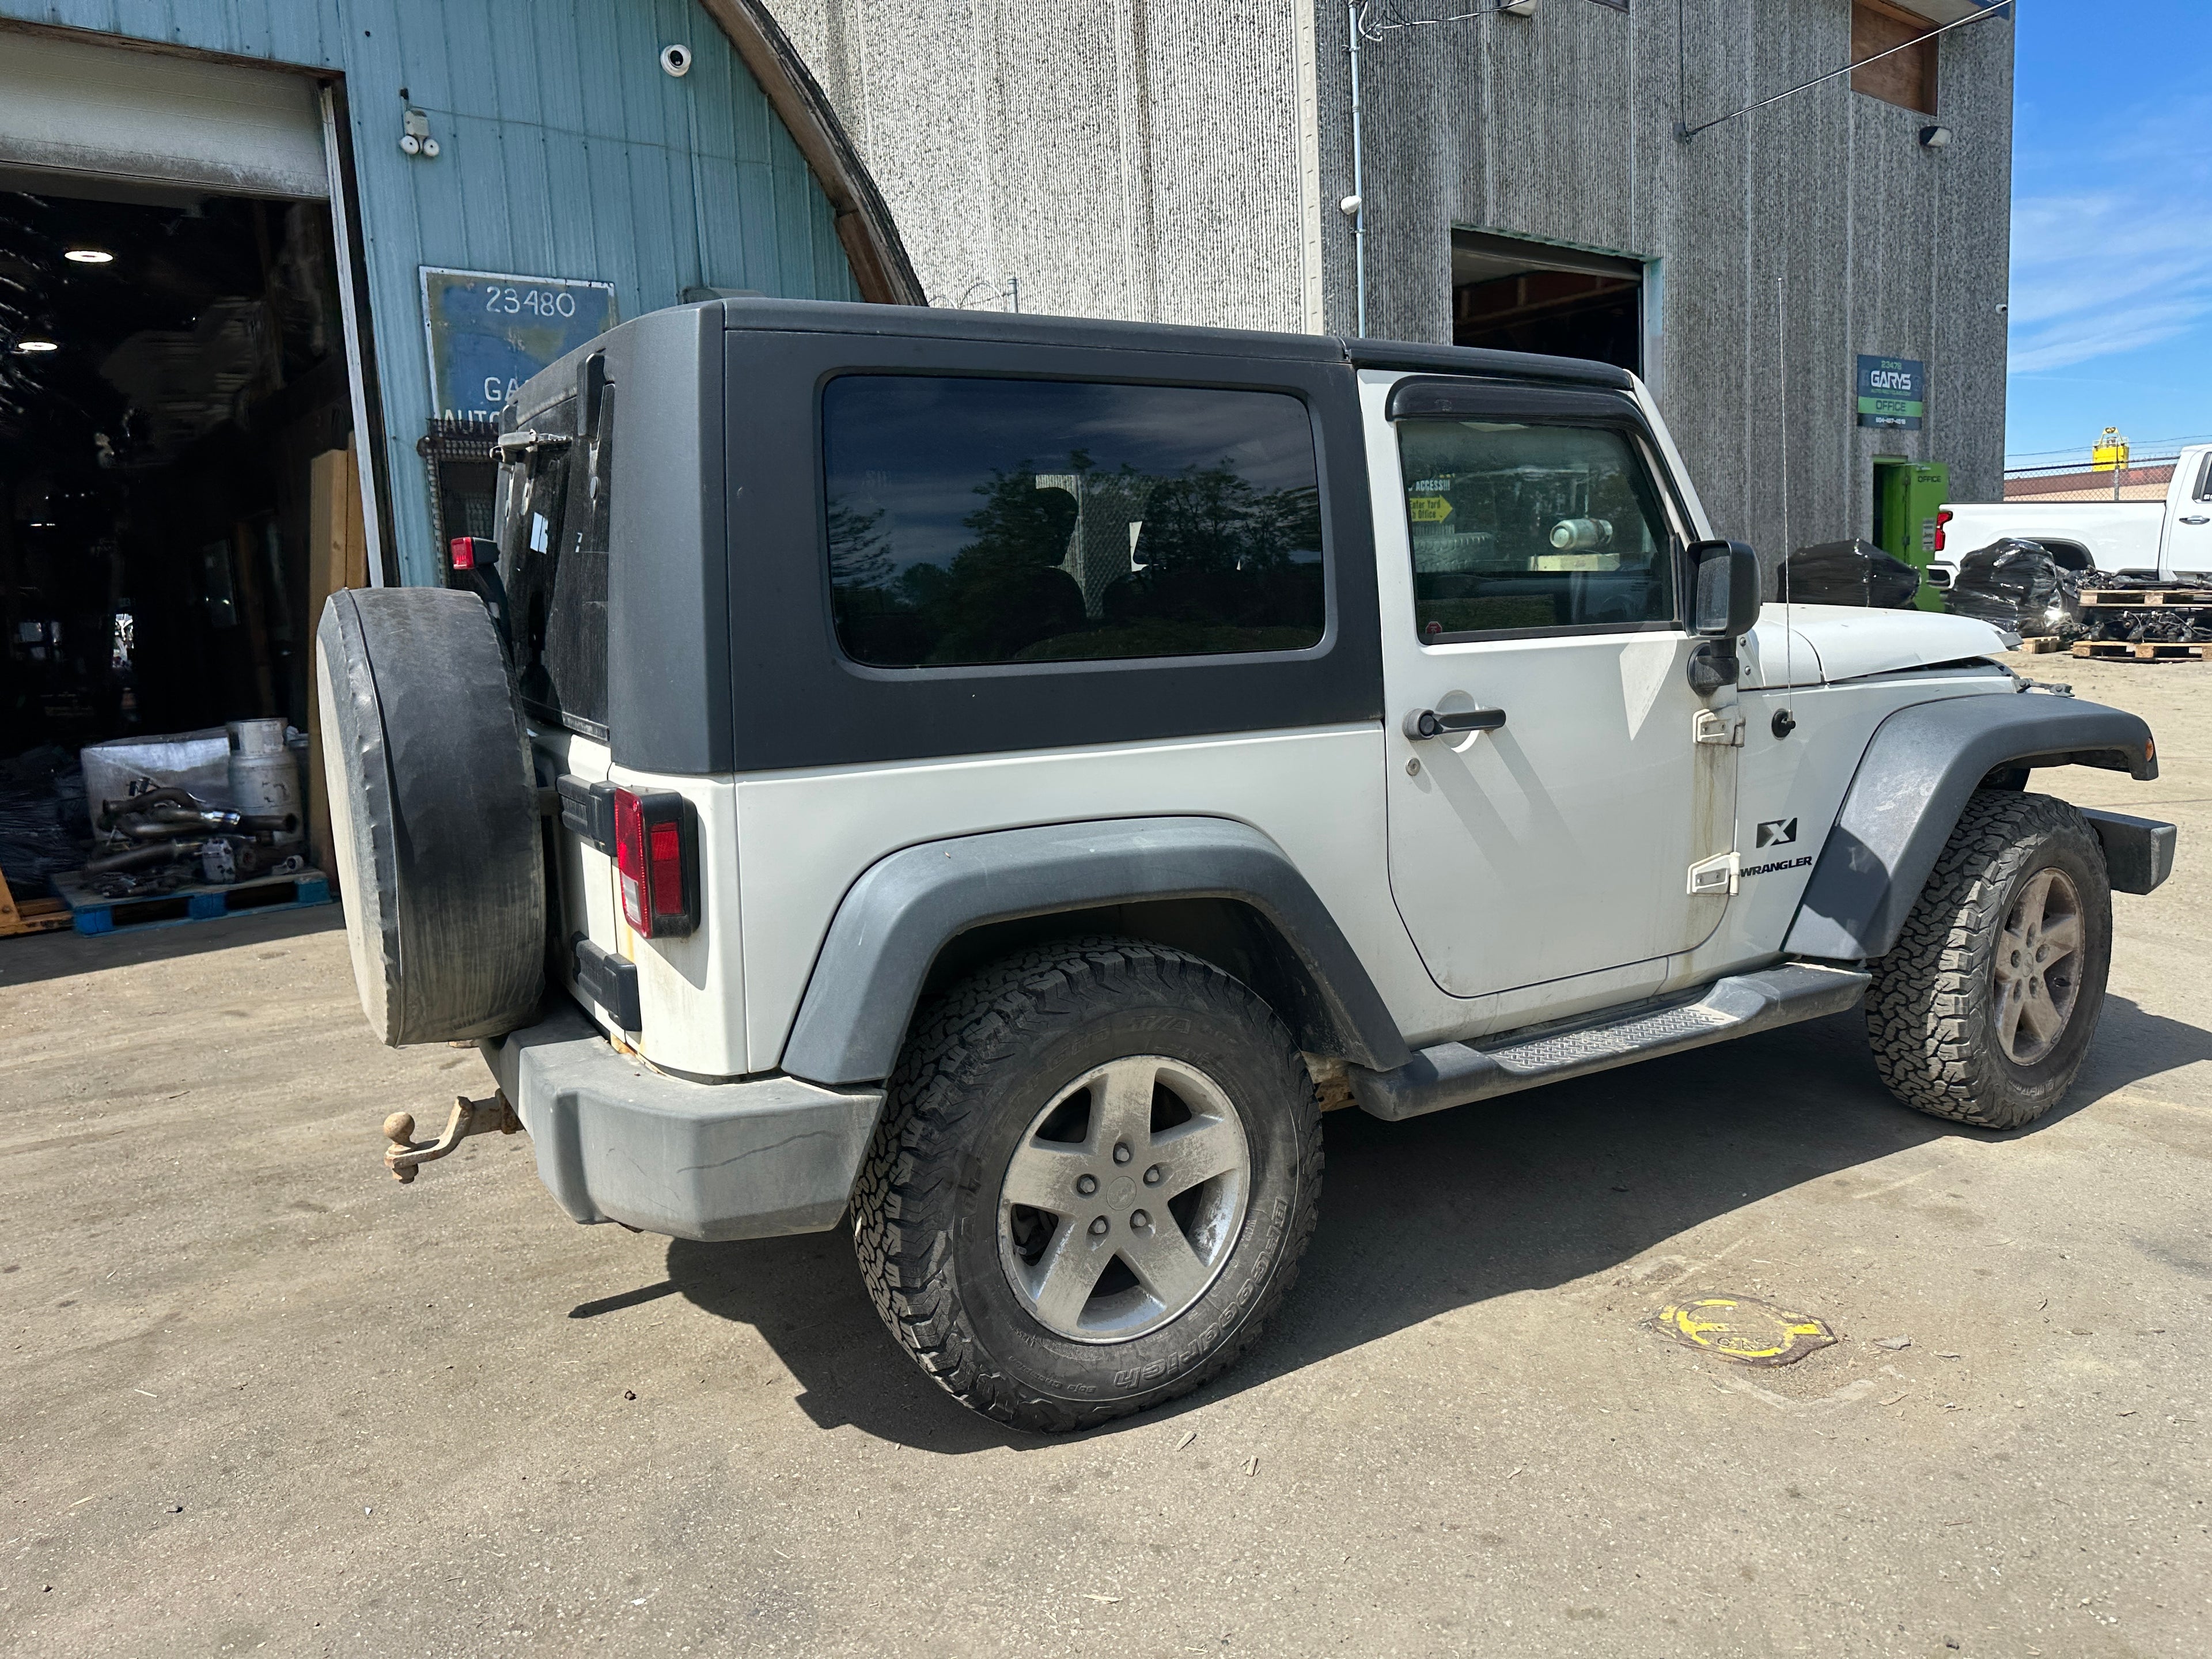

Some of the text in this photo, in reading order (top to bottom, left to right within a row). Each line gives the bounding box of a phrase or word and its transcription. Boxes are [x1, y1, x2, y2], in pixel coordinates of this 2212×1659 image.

[487, 286, 575, 317] 23480
[1870, 370, 1911, 390] GARYS
[1876, 400, 1906, 412] OFFICE
[1740, 856, 1812, 877] WRANGLER
